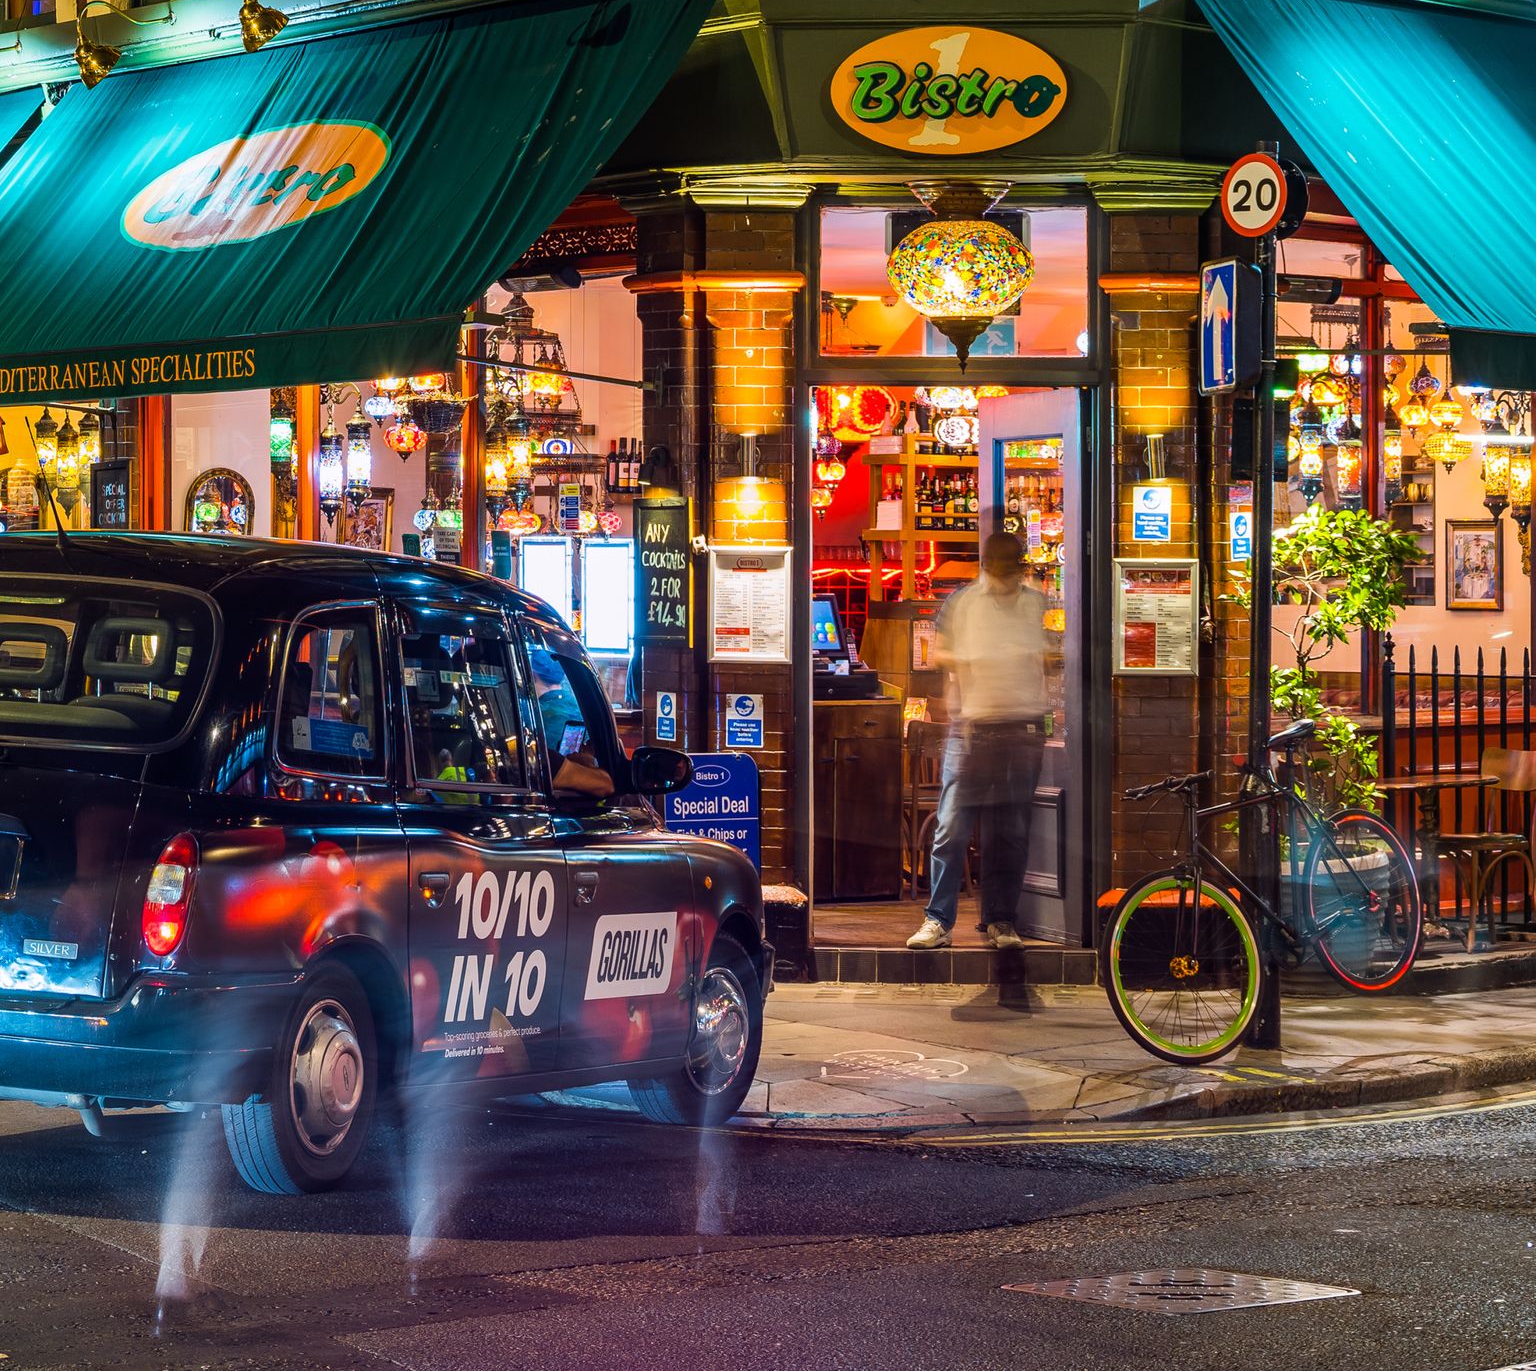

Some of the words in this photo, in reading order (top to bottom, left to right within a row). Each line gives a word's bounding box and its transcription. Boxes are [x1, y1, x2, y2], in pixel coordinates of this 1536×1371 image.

[851, 61, 1061, 124] Bistro
[1232, 178, 1277, 212] 20
[131, 348, 256, 386] SPECIALITIES
[102, 484, 126, 496] SPECIAL
[645, 523, 670, 543] ANY
[642, 548, 686, 571] COCKTAILS
[650, 577, 659, 596] 2
[661, 577, 681, 598] FOR
[695, 771, 719, 780] Bistro
[721, 771, 724, 779] 1
[673, 797, 718, 818] Special
[721, 796, 749, 813] Deal
[707, 828, 735, 841] Chips
[737, 830, 748, 839] or
[455, 869, 555, 939] 10/10
[29, 942, 70, 956] SILVER
[597, 928, 668, 983] GORILLAS
[444, 954, 494, 1022] IN
[504, 949, 547, 1017] 10
[444, 1031, 475, 1043] Top-scoring
[475, 1030, 498, 1042] groceries
[498, 1029, 503, 1037] &
[503, 1028, 521, 1039] perfect
[444, 1048, 470, 1058] Delivered
[471, 1047, 476, 1055] in
[477, 1046, 483, 1055] 10
[483, 1045, 504, 1055] minutes.
